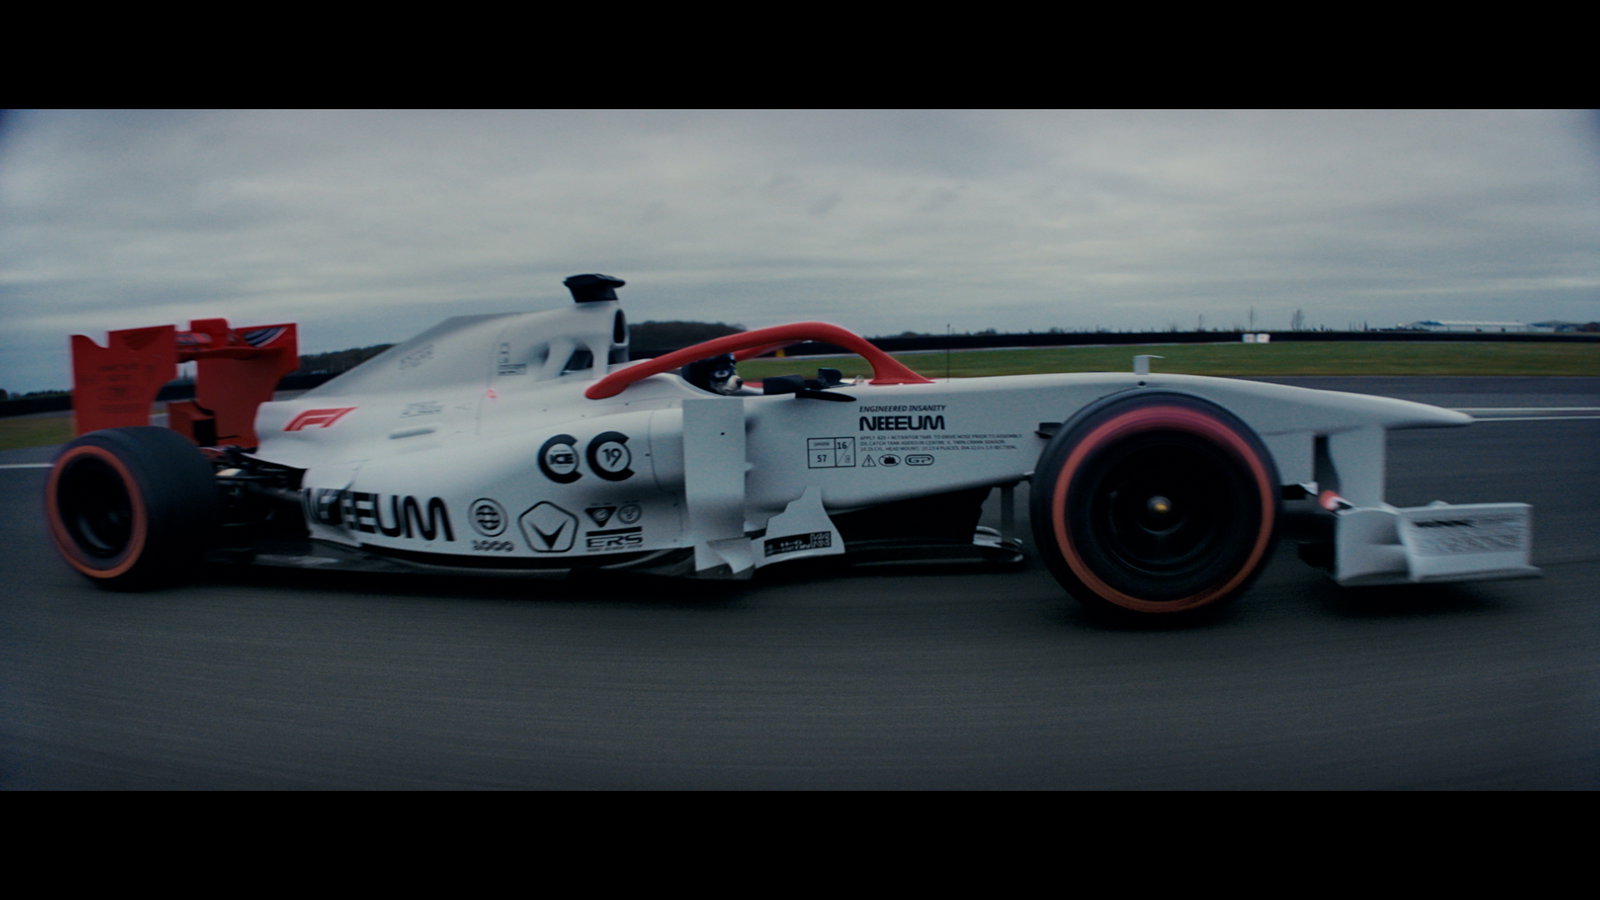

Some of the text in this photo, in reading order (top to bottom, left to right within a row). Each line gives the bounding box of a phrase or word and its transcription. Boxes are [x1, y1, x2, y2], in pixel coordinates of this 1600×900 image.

[859, 404, 946, 413] ENGINEERED INSANITY
[859, 414, 946, 431] NEEEUM
[836, 441, 848, 450] 16
[602, 447, 622, 467] 19
[816, 454, 828, 463] 57
[586, 534, 642, 548] ERS
